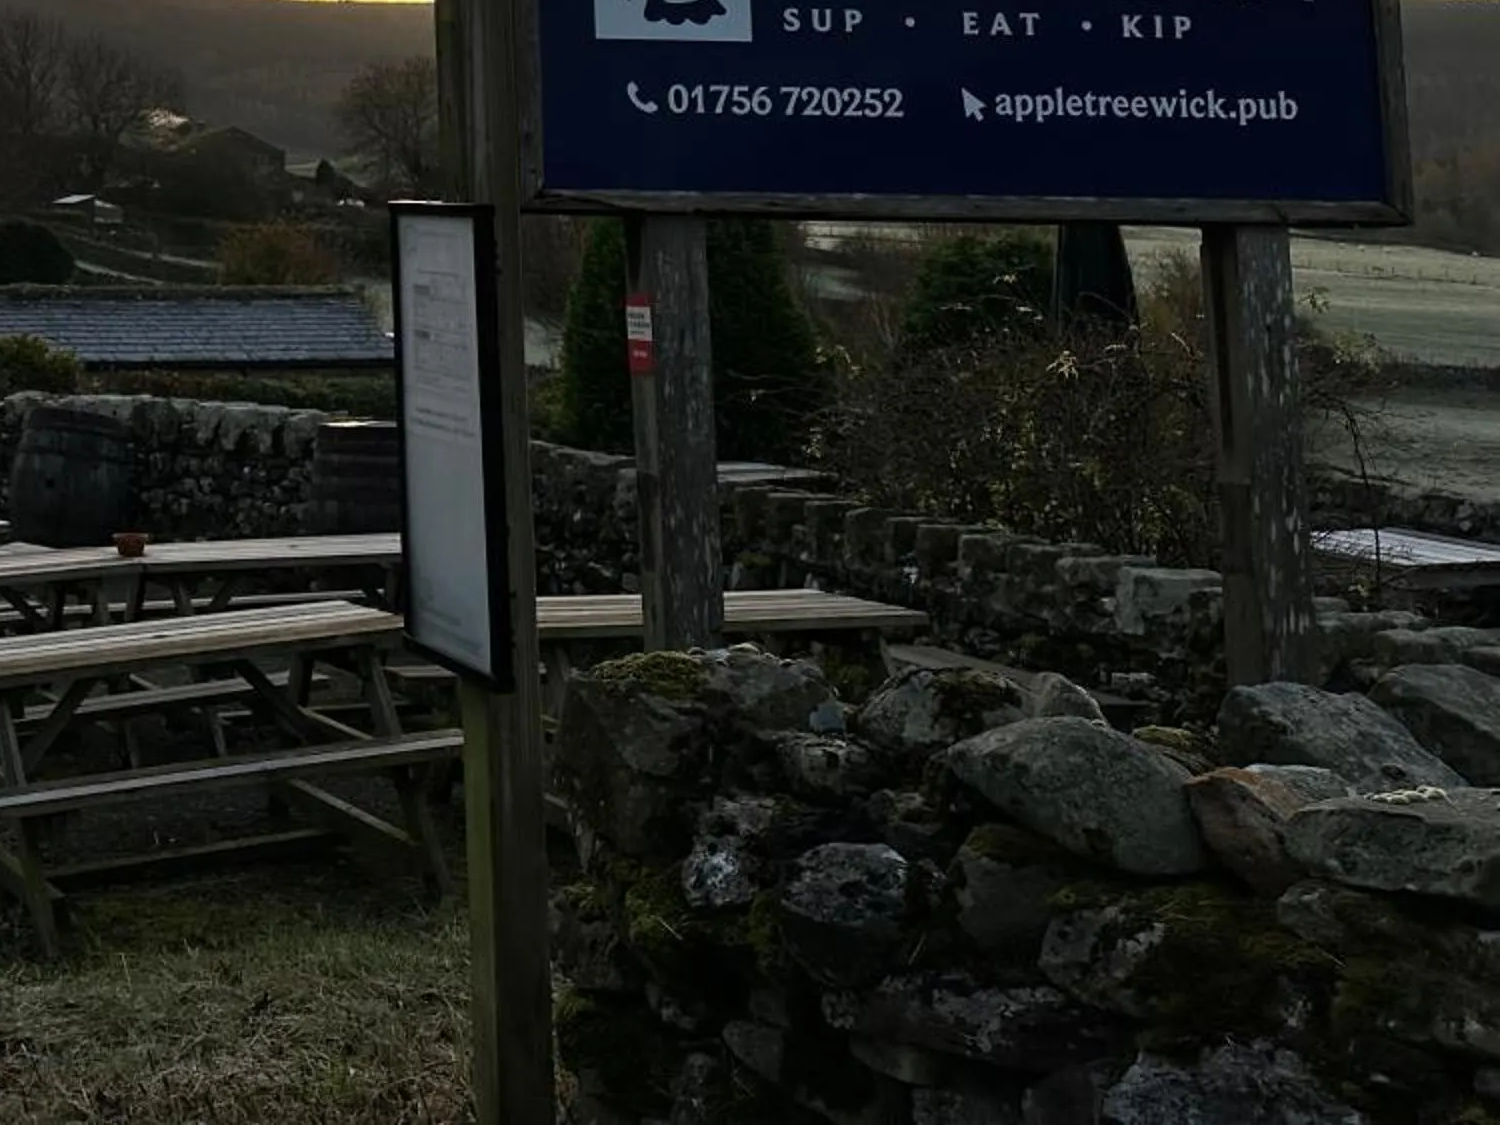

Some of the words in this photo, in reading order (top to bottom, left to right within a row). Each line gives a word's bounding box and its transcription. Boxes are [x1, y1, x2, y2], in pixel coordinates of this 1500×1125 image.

[783, 7, 864, 33] SUP
[961, 11, 1042, 37] EAT
[1121, 14, 1193, 40] KIP
[667, 83, 774, 116] 01756
[780, 85, 905, 118] 720252
[994, 85, 1299, 126] appletreewick.pub
